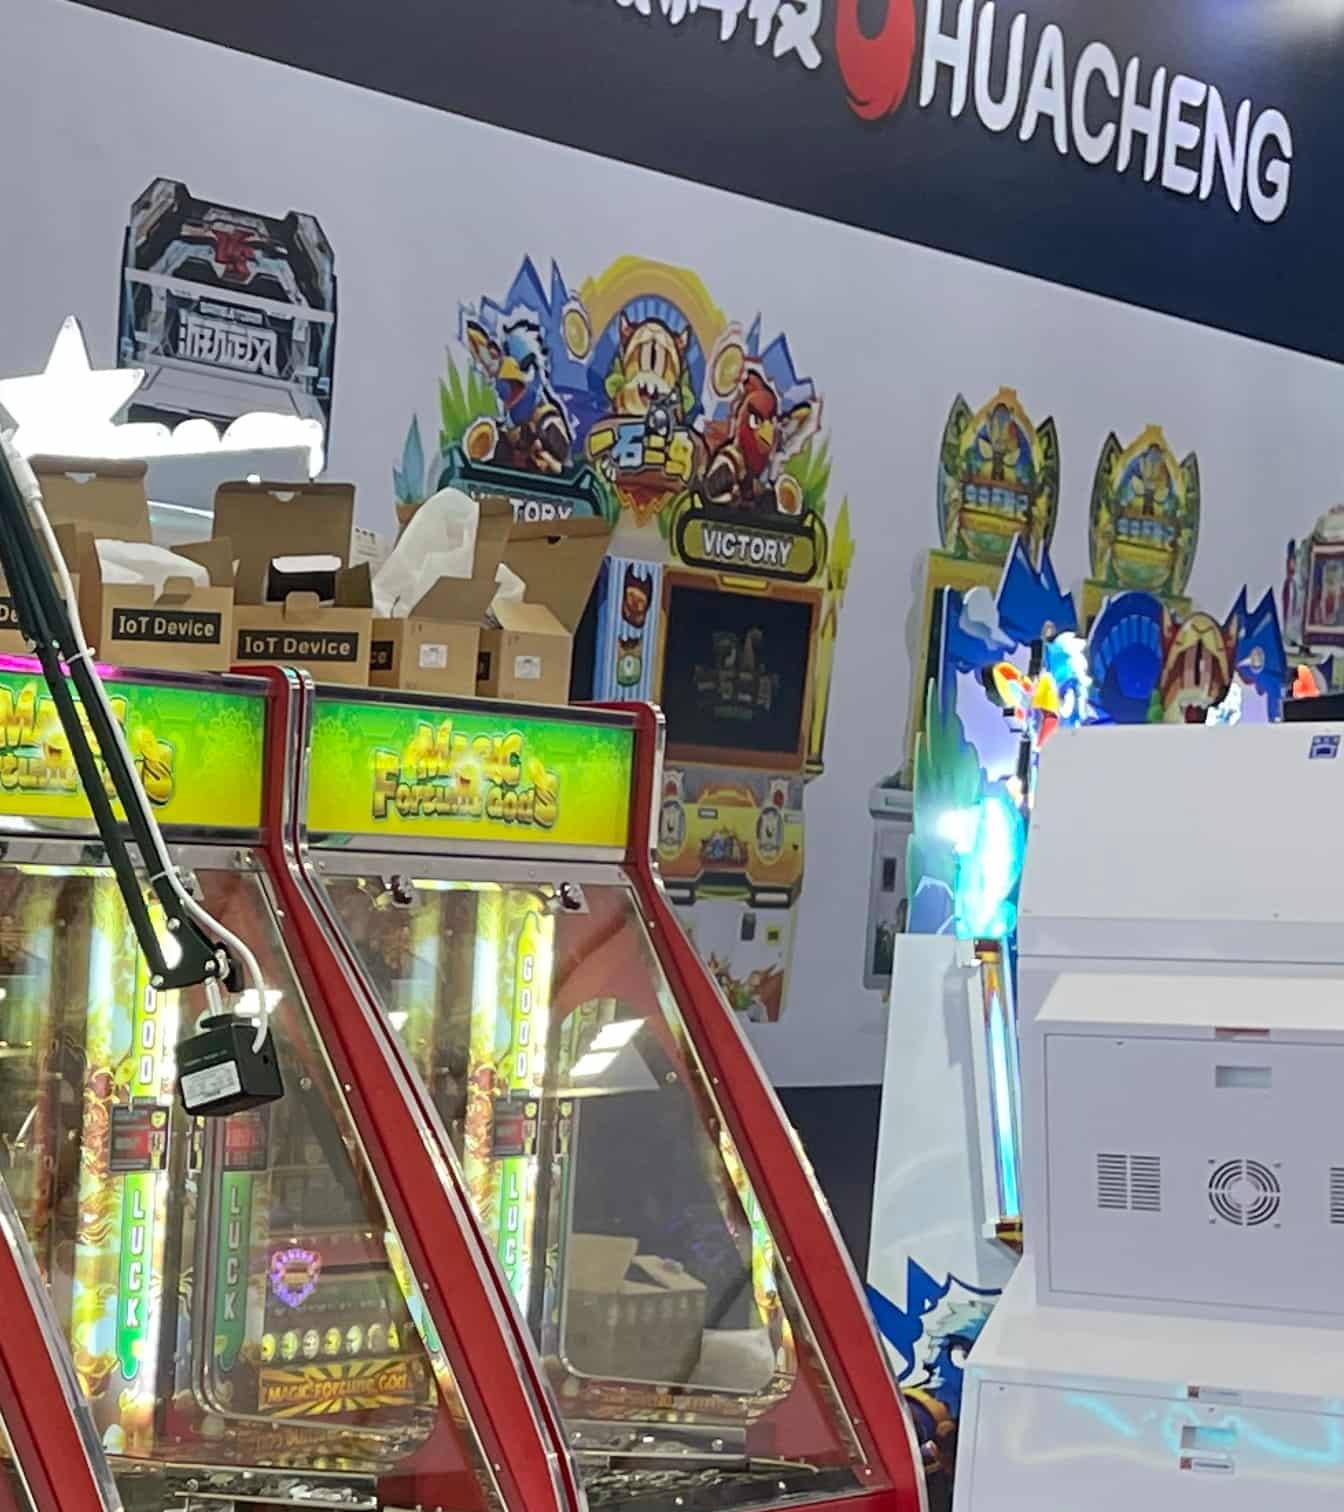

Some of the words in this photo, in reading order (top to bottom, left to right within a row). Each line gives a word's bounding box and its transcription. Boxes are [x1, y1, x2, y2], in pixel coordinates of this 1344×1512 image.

[920, 0, 1292, 222] HUACHENG
[703, 528, 792, 564] VICTORY
[119, 615, 150, 634] IoT
[153, 617, 216, 637] Device
[244, 634, 278, 654] IoT
[283, 636, 352, 657] Device
[417, 721, 523, 787] MAGIC
[513, 955, 534, 1079] GOOD
[126, 1187, 144, 1328] LUCK
[226, 1186, 241, 1321] LUCK
